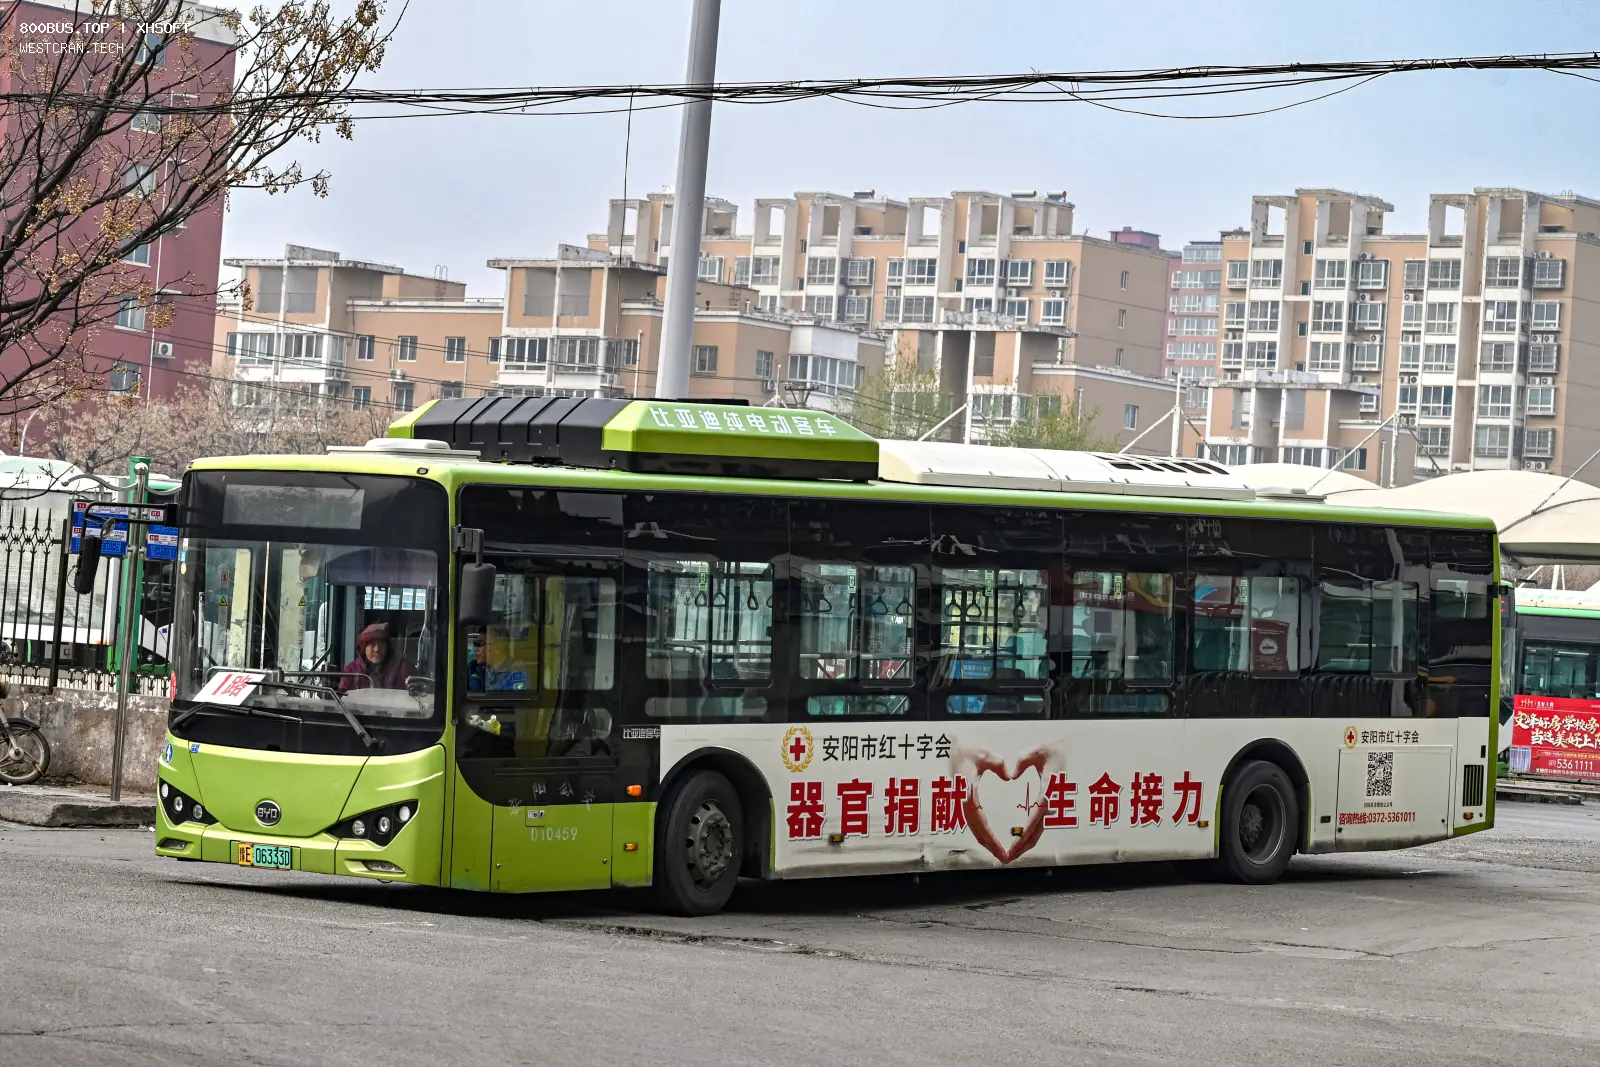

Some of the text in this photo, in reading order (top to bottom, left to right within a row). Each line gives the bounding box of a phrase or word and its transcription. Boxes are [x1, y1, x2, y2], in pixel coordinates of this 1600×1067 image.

[649, 406, 836, 436] 比亚迪纯电动客车
[623, 728, 661, 739] 比亚迪客车
[1361, 730, 1420, 744] 安阳市红十字会
[822, 733, 952, 762] 安阳市红十字会
[1556, 758, 1593, 771] 5361111
[1044, 771, 1204, 827] 生命接力
[257, 807, 278, 819] BYD
[786, 775, 968, 838] 器官捐献
[1338, 811, 1416, 825] 咨询热线:0372-5361011
[531, 827, 578, 841] D10459
